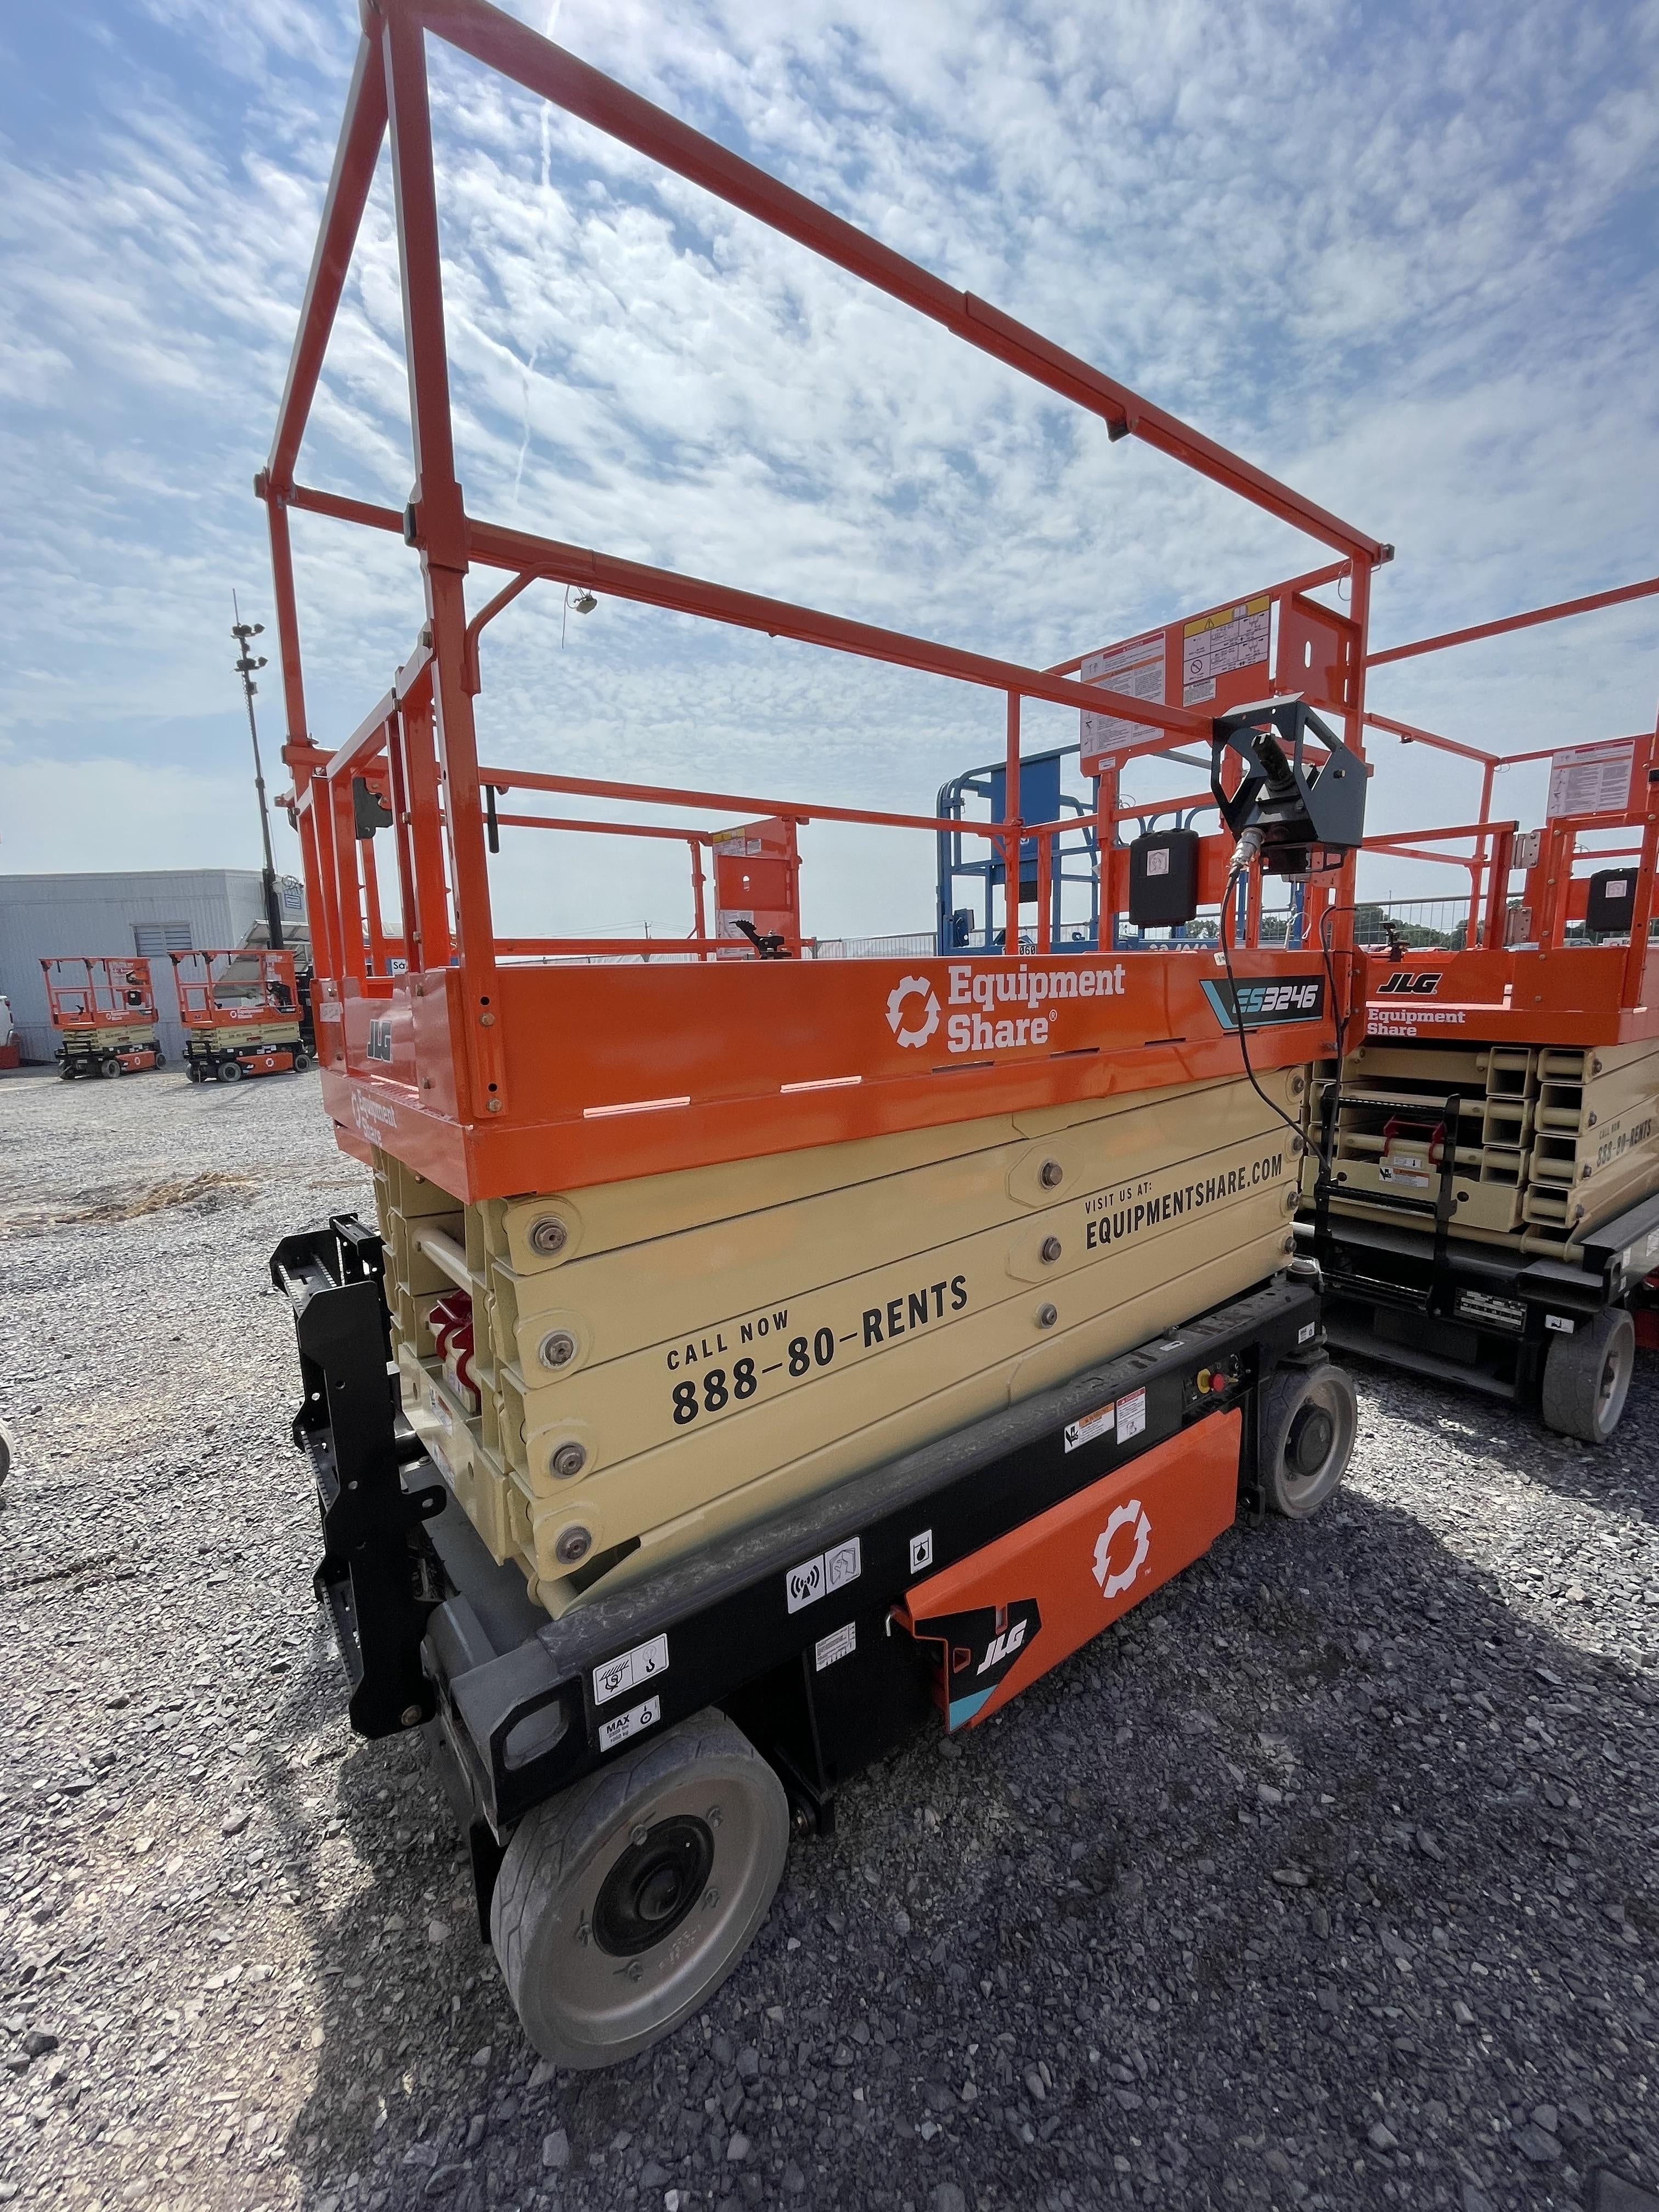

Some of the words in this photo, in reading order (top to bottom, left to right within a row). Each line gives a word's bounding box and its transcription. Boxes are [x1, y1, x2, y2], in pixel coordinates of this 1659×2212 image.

[948, 964, 1126, 1012] Equipment
[1232, 985, 1319, 1014] ES3246
[1376, 973, 1443, 995] JLG
[1367, 1008, 1466, 1025] Equipment
[1367, 1022, 1418, 1036] Share
[366, 1019, 393, 1064] JLG
[1085, 1193, 1114, 1214] VISIT
[1119, 1187, 1132, 1203] US
[1137, 1181, 1152, 1196] AT:
[1086, 1153, 1283, 1250] EQUIPMENTSHARE.COM
[667, 1334, 728, 1370] CALL
[740, 1310, 788, 1344] NOW
[672, 1275, 968, 1425] 888-80-RENTS
[977, 1618, 1028, 1677] JLG
[606, 1714, 630, 1734] MAX
